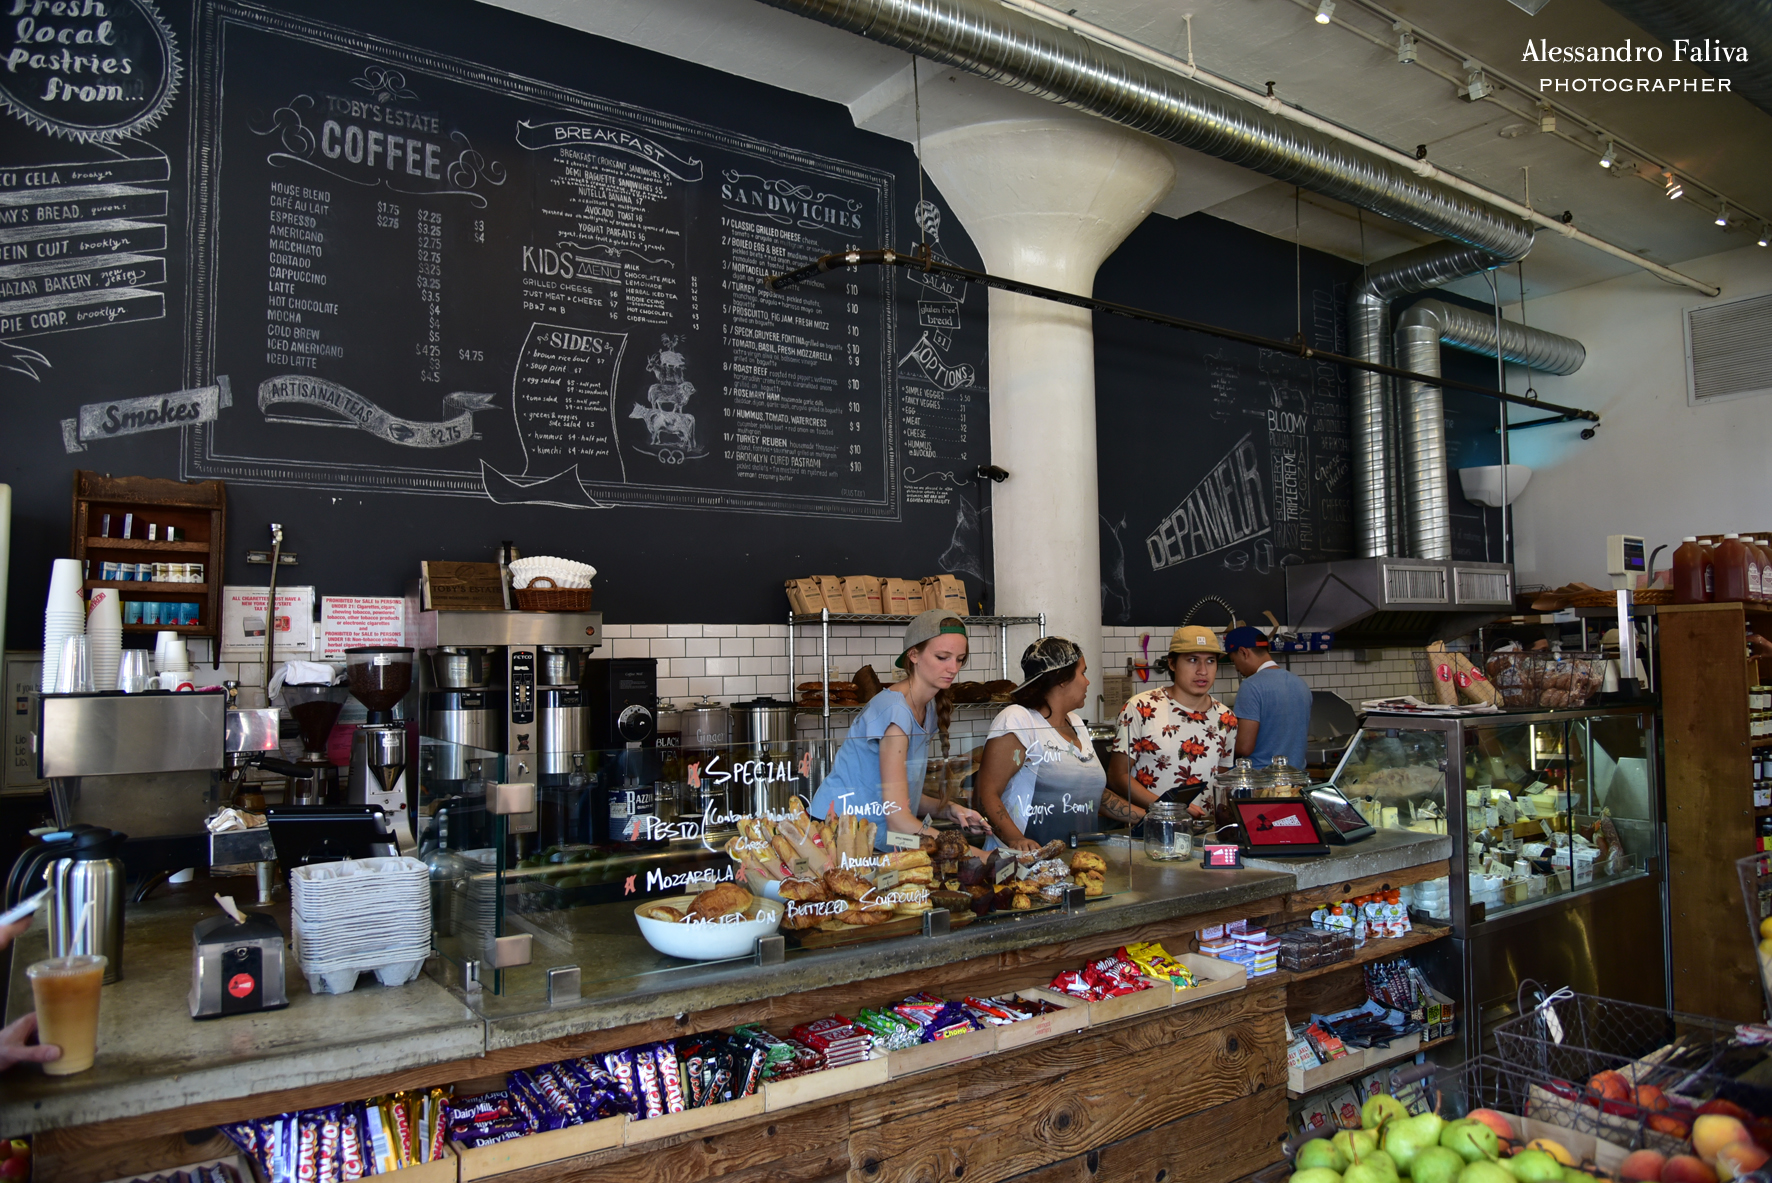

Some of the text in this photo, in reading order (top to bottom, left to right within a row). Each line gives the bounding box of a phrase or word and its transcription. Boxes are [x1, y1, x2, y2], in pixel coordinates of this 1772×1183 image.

[14, 17, 116, 46] local
[326, 95, 439, 134] TOBY'S ESTATE
[322, 120, 440, 180] COFFEE
[555, 127, 664, 160] BREAKFAST
[560, 148, 596, 162] BREAKFAST
[585, 171, 615, 184] BAGUETTE
[271, 182, 330, 203] HOUSE BLEND
[579, 187, 606, 199] NUTELLA
[295, 200, 306, 211] AU
[310, 203, 329, 215] LAIT
[585, 206, 633, 220] AVOCADO TOAST
[722, 184, 861, 229] SANDWICHES
[270, 210, 316, 228] ESPRESSO
[418, 209, 441, 224] $2.25
[270, 224, 323, 242] AMERICANO
[578, 223, 635, 239] YOGURT PARFAITS
[731, 219, 800, 242] CLASSIC GRILLED CHEESE
[80, 237, 130, 251] brooklyn
[270, 238, 322, 257] MACCHIATO
[731, 238, 786, 256] BOILED EGG BEET
[270, 252, 310, 268] CORTADO
[523, 246, 620, 279] KIDS MENU
[270, 266, 326, 285] CAPPUCCINO
[269, 281, 295, 294] LATTE
[523, 278, 593, 294] GRILLED CHEESE
[732, 282, 755, 293] TURKEY
[269, 296, 338, 315] HOT CHOCOLATE
[523, 290, 602, 307] JUST MEAT CHEESE
[267, 309, 301, 323] MOCHA
[430, 303, 440, 316] $4
[921, 304, 940, 314] gluten
[1, 318, 23, 334] PIE
[77, 306, 126, 321] brooklyn
[928, 315, 952, 326] bread
[268, 324, 320, 340] COLD BREW
[430, 330, 440, 342] $5
[268, 338, 343, 358] ICED AMERICANO
[550, 332, 603, 354] SIDES
[267, 353, 316, 368] ICED LATTE
[459, 349, 484, 361] $4.75
[533, 349, 556, 360] brown
[531, 363, 547, 371] soup
[733, 363, 768, 376] ROAST BEEF
[920, 348, 967, 386] OPTIONS
[733, 388, 780, 401] ROSEMARY HAM
[905, 386, 944, 400] SIMPLE VEGGIES
[102, 400, 200, 433] Smokes
[344, 398, 372, 423] TEAS
[791, 416, 826, 428] WATERCRESS
[906, 416, 920, 425] MEAT
[1268, 410, 1307, 434] BLOOMY
[431, 426, 461, 443] $2.75
[534, 431, 562, 440] hummus
[736, 434, 787, 448] TURKEY REUBEN
[907, 428, 926, 439] CHEESE
[537, 445, 561, 454] kimchi
[908, 440, 932, 450] HUMMUS
[736, 451, 768, 463] BROOKLYN
[770, 455, 789, 466] CURED
[705, 756, 799, 785] SPECIAL
[838, 792, 901, 816] TOMATOES
[1018, 794, 1054, 824] Veggie
[647, 816, 699, 840] PESTO
[841, 852, 890, 870] ARUGULA
[647, 864, 734, 891] MOZZARELLA
[756, 909, 775, 924] ON
[453, 1106, 478, 1120] Dairy
[476, 1134, 503, 1147] Dairy
